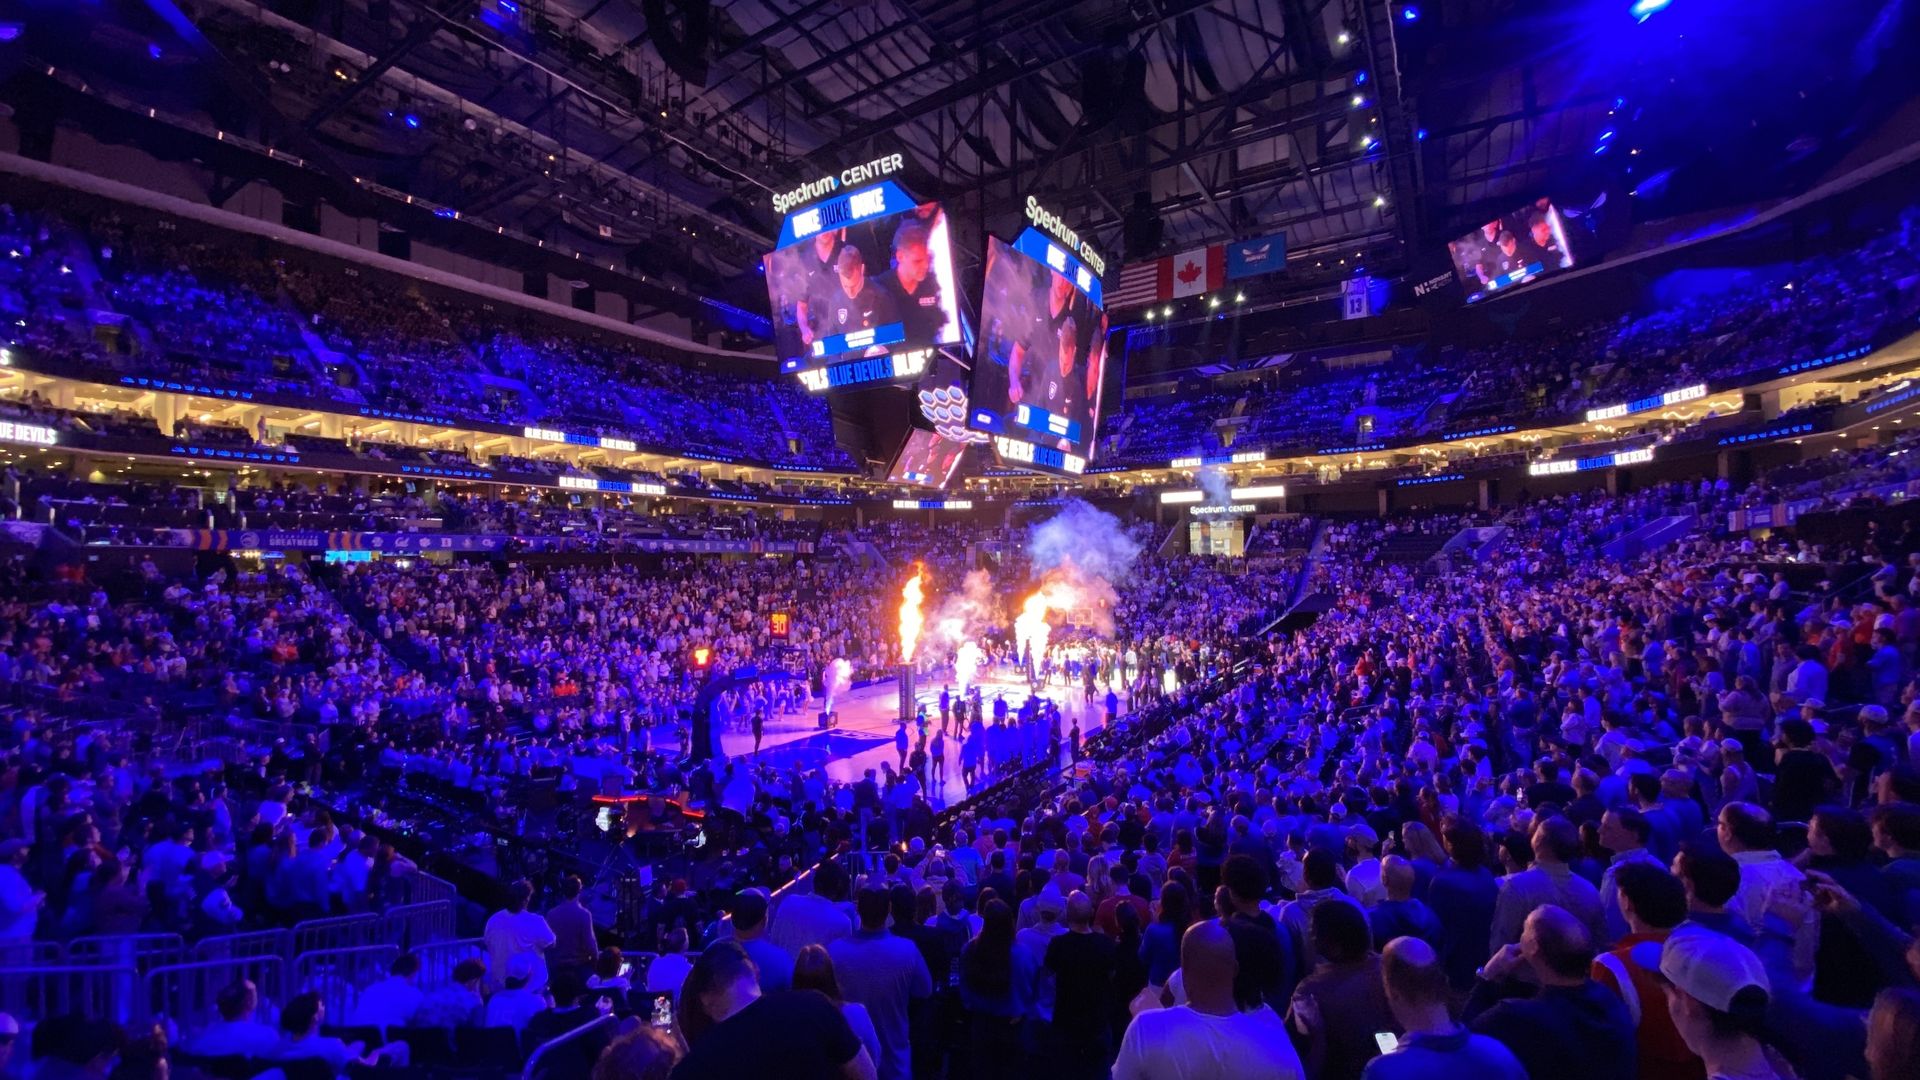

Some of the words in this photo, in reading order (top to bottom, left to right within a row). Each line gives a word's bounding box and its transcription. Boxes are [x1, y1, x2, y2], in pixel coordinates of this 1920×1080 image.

[772, 175, 836, 214] Spectrum
[841, 153, 904, 187] CENTER
[821, 200, 850, 226] DUKE
[1025, 195, 1078, 249] Spectrum
[1080, 241, 1105, 277] CENTER
[1350, 298, 1363, 315] 13
[828, 364, 854, 387] BLUE
[854, 357, 893, 383] DEVILS
[15, 424, 57, 445] DEVILS
[1189, 506, 1225, 515] Spectrum
[1228, 504, 1256, 513] CENTER
[269, 538, 319, 547] GREATNESS
[772, 621, 787, 634] 30
